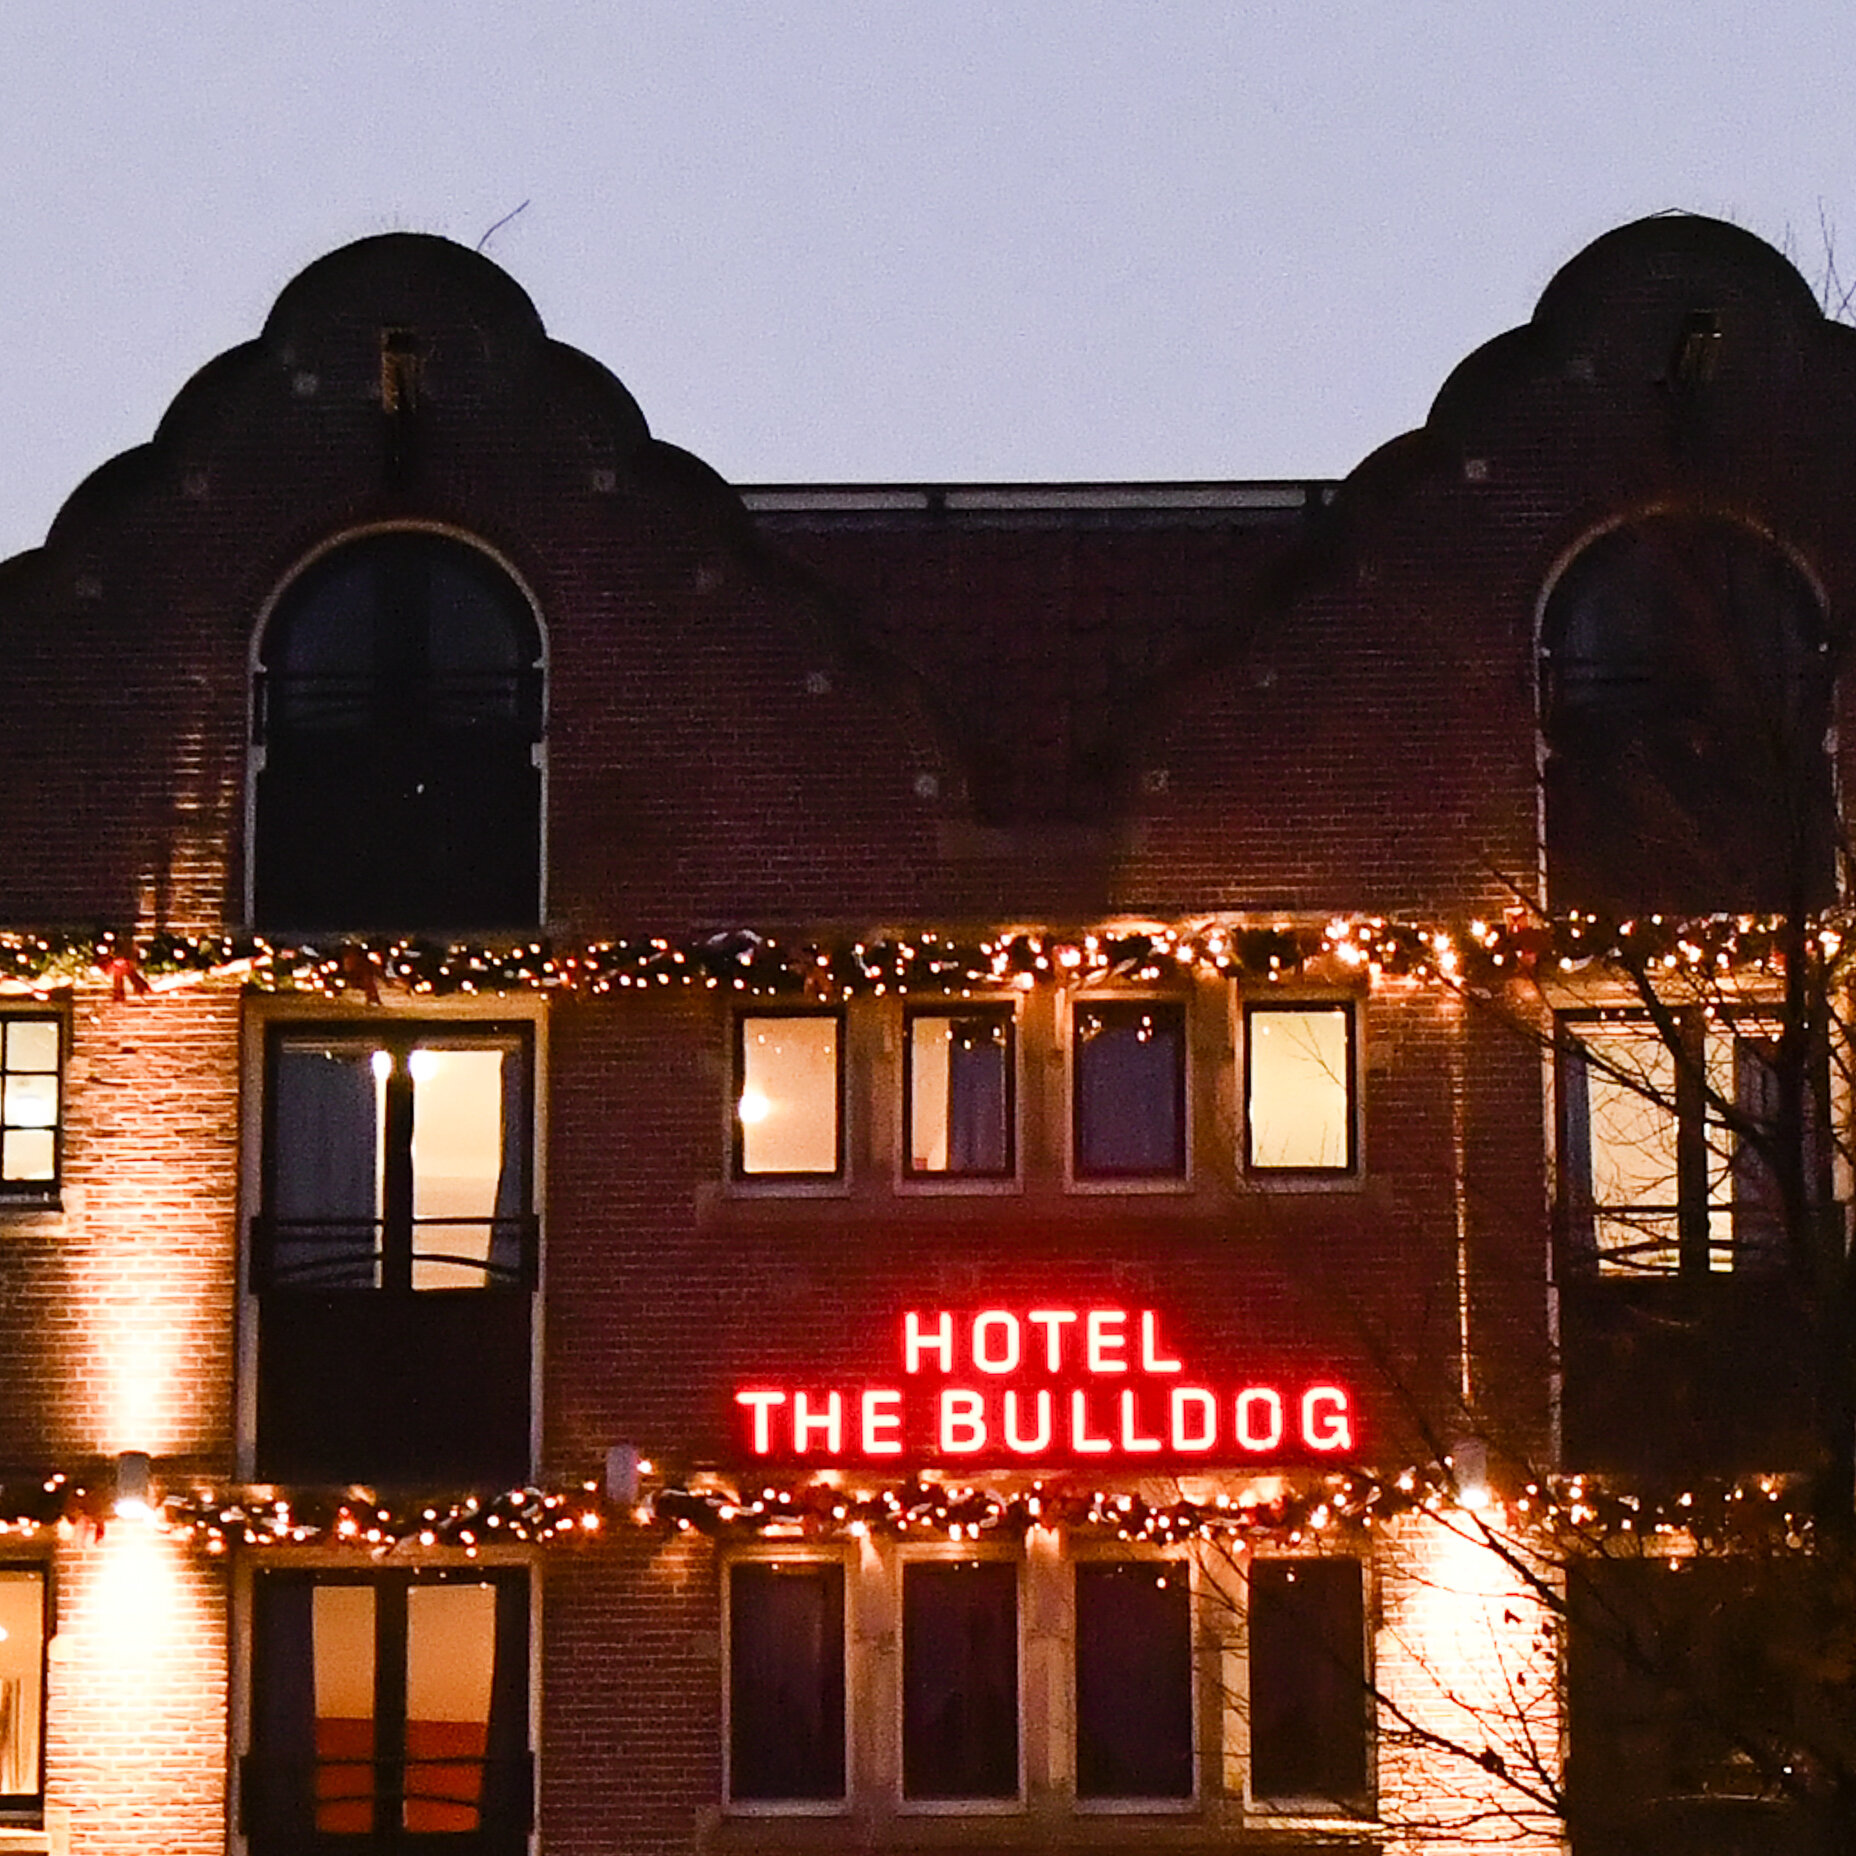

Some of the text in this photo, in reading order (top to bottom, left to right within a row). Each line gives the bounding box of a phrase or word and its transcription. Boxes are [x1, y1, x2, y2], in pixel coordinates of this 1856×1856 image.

[903, 1310, 1182, 1374] HOTEL
[736, 1387, 1352, 1454] THE BULLDOG
